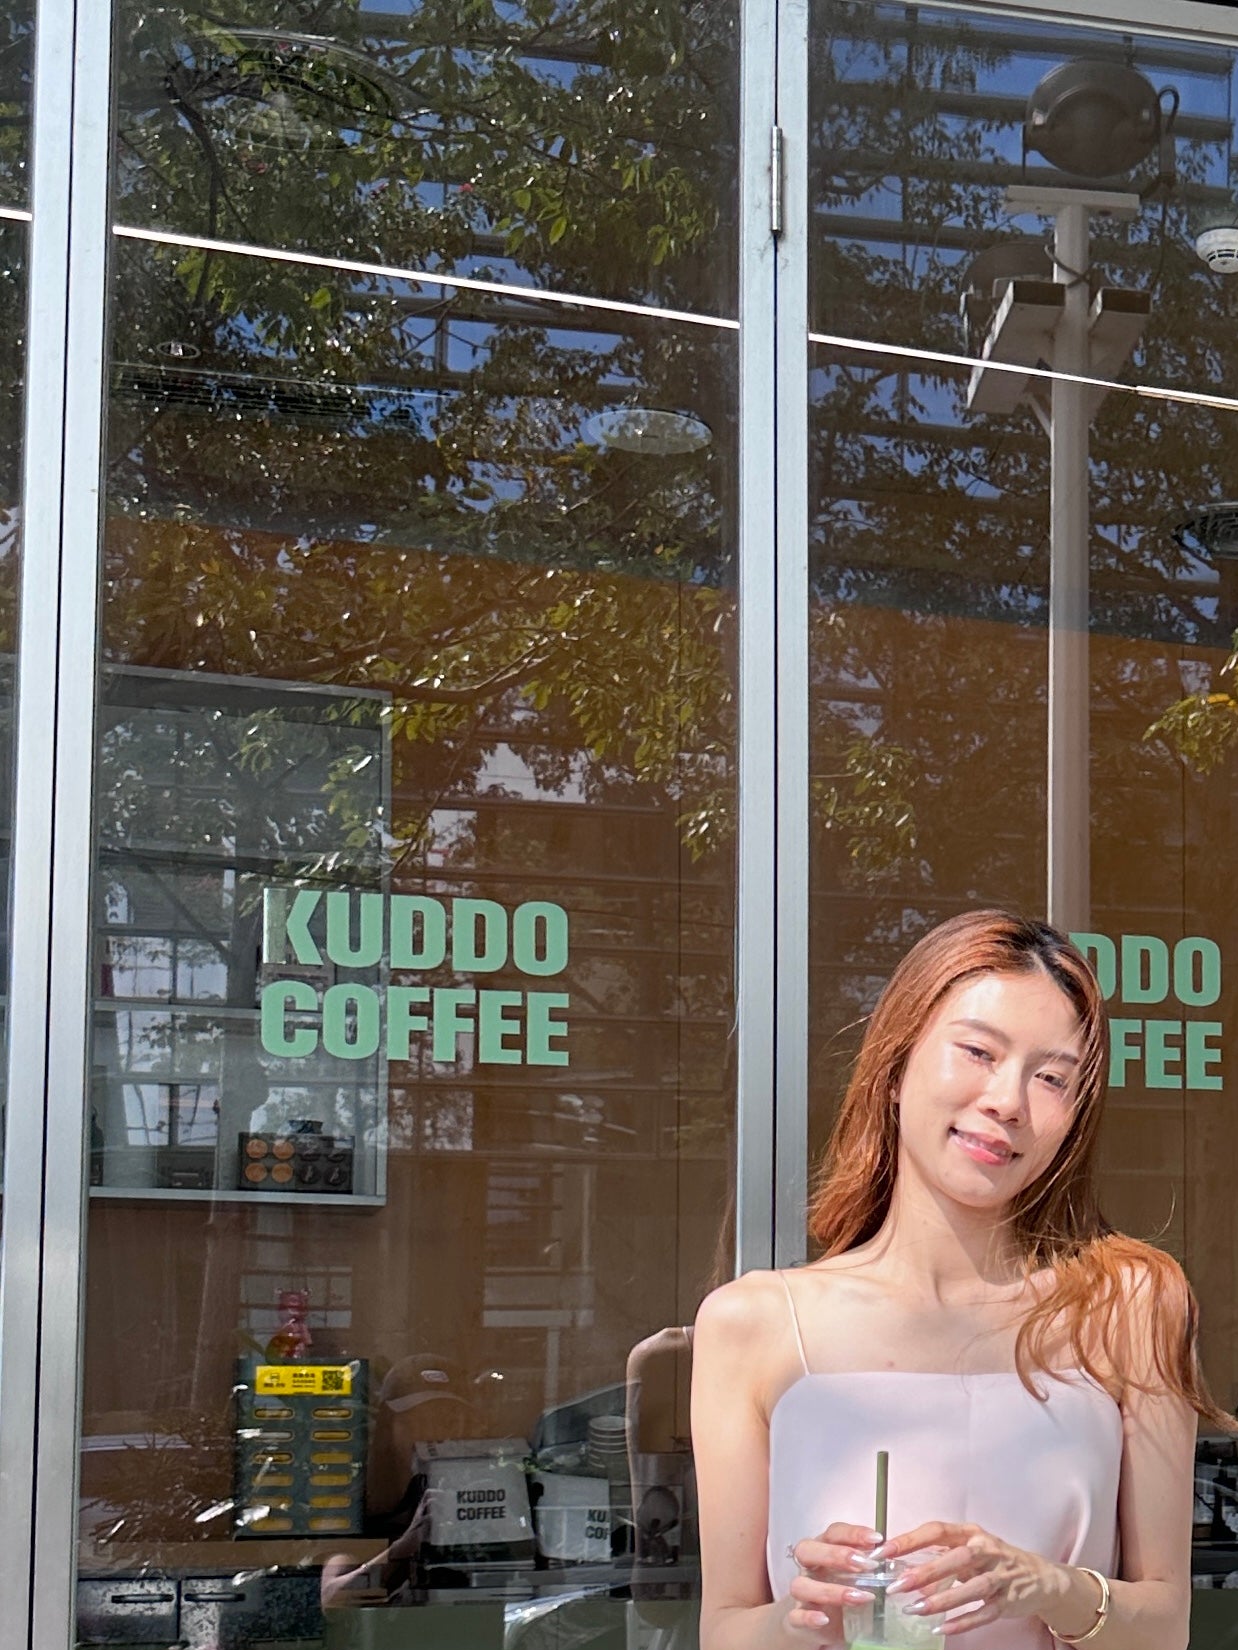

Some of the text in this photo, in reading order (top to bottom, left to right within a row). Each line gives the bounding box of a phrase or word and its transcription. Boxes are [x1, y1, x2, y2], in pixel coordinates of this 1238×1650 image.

[262, 887, 569, 977] KUDDO
[261, 980, 570, 1067] COFFEE
[456, 1488, 506, 1504] KUDDO
[456, 1505, 507, 1521] COFFEE
